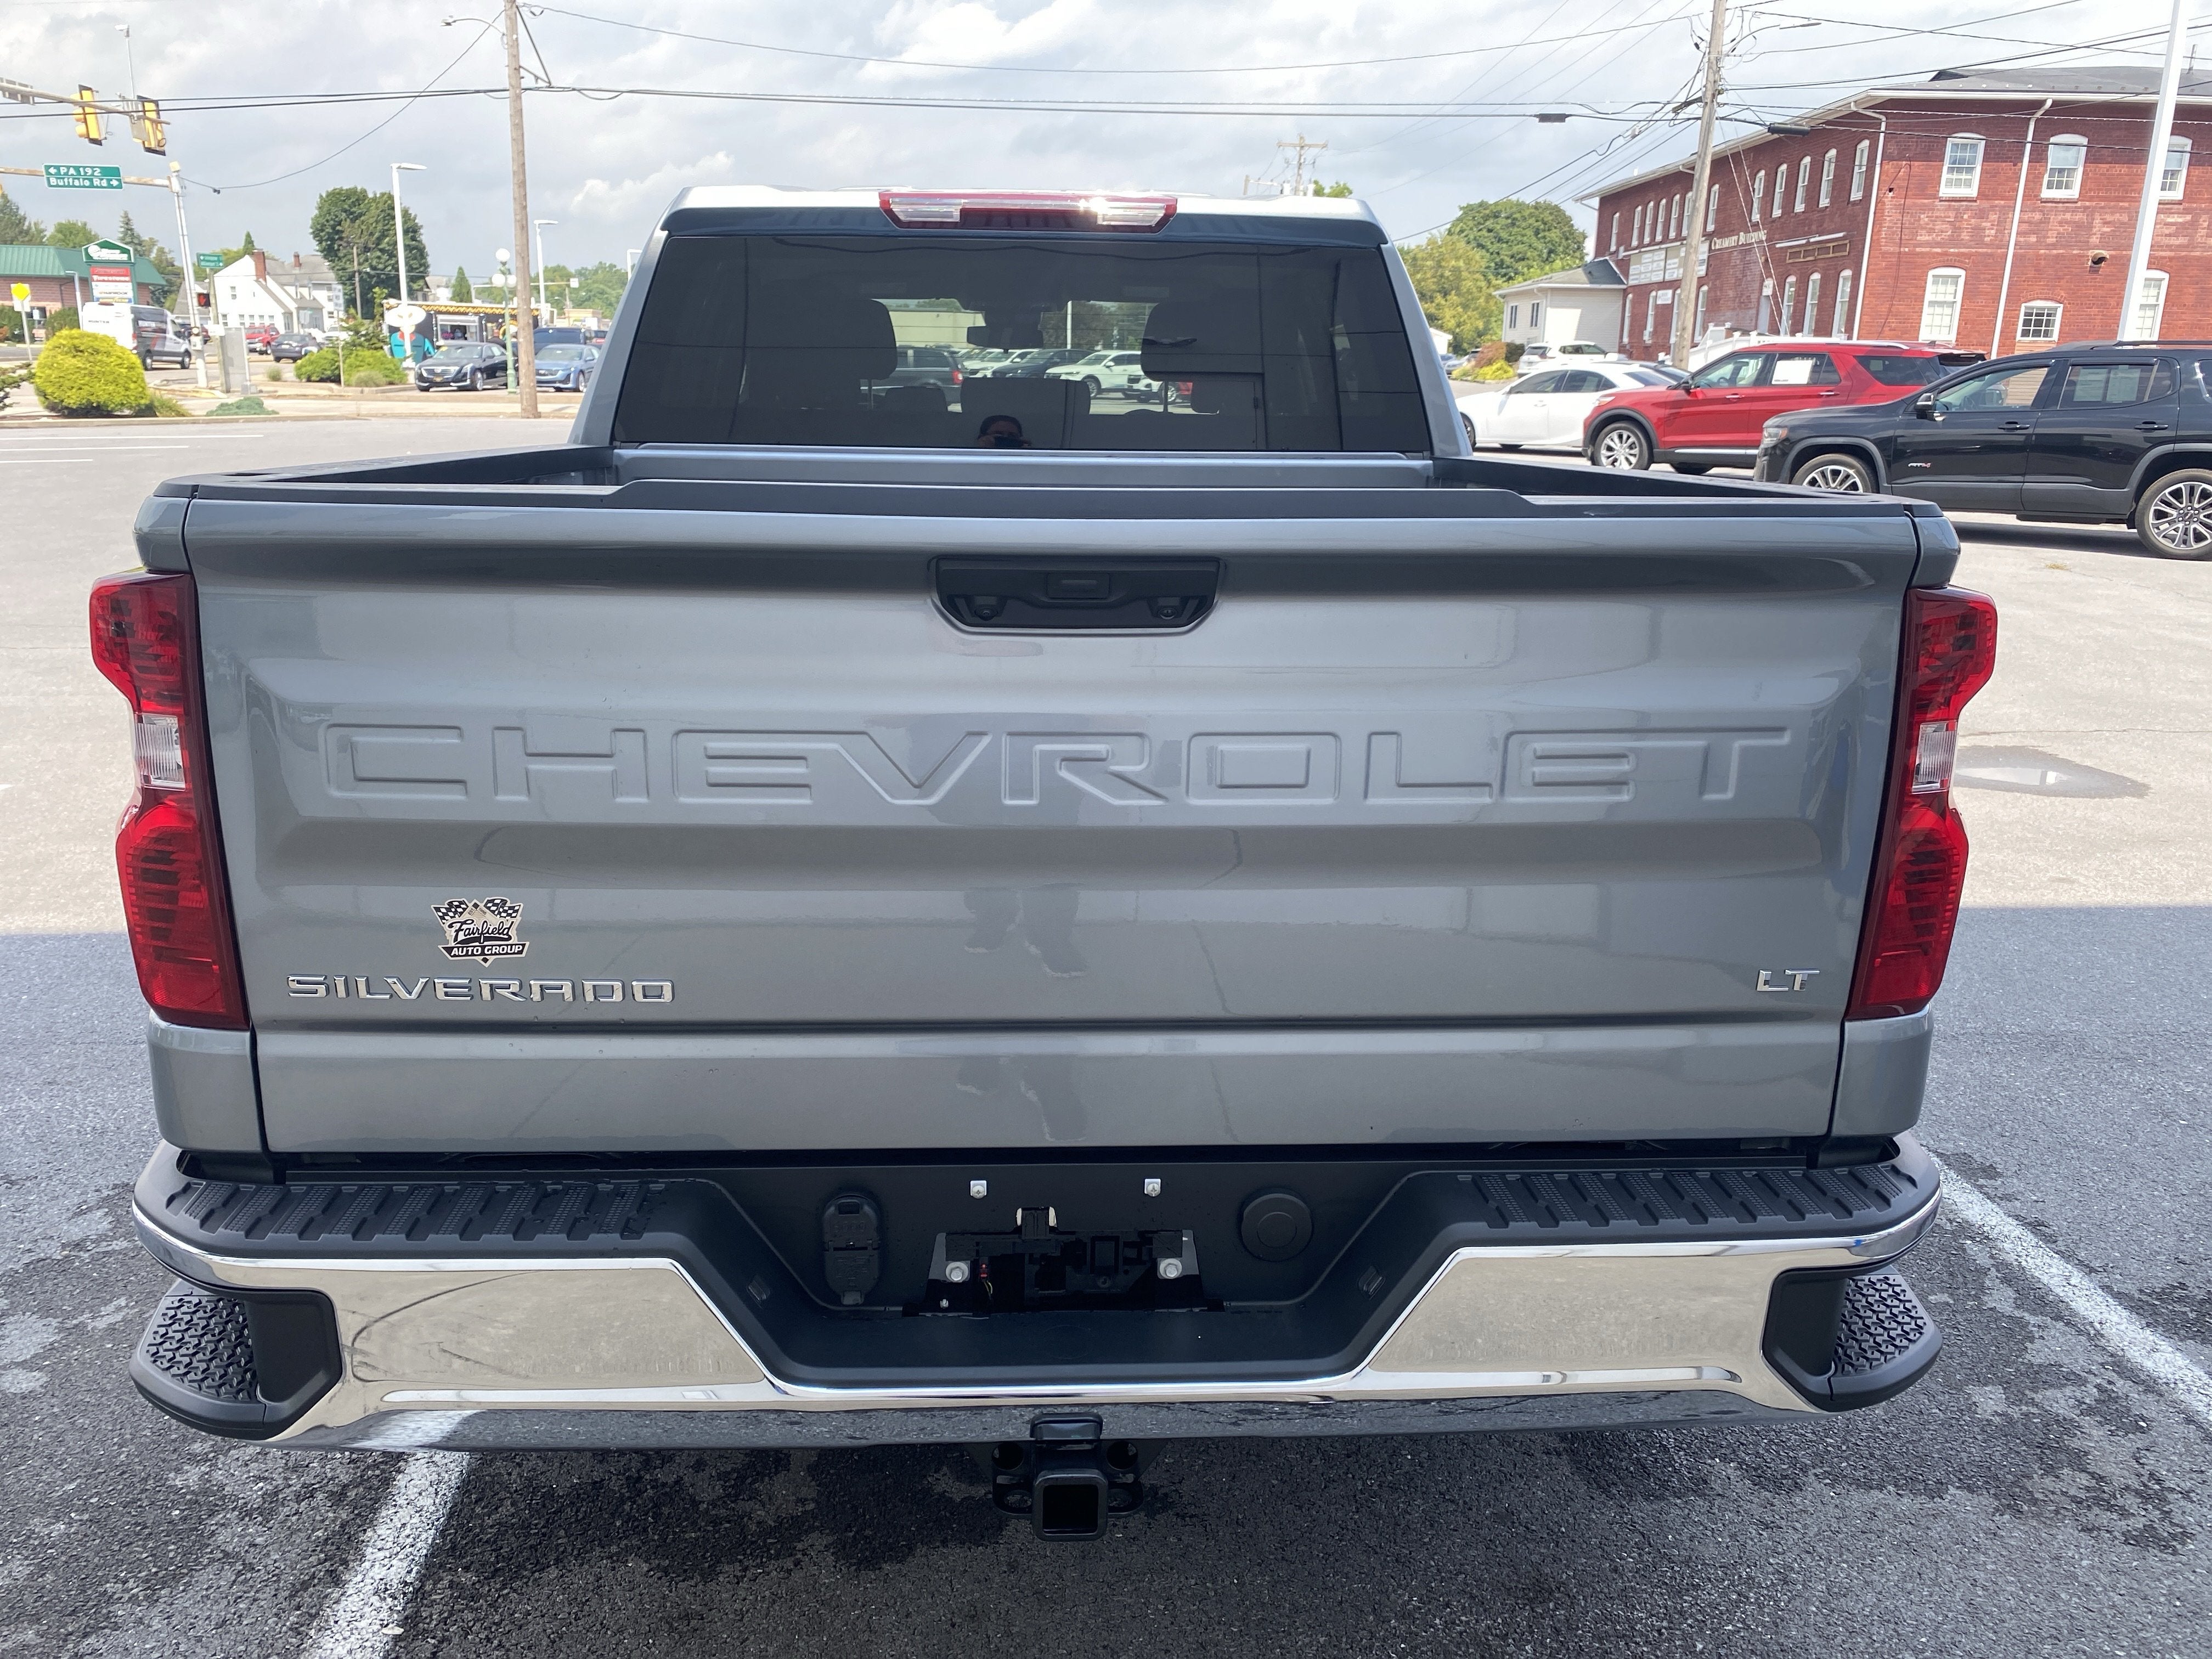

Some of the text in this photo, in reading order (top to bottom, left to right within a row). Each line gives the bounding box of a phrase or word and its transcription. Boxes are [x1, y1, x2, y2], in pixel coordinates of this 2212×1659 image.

[49, 177, 108, 187] Buffalo Rd
[59, 166, 101, 176] PA 192
[324, 723, 1792, 806] CHEVROLET
[448, 919, 514, 944] Fairfield
[451, 945, 522, 956] AUTO GROUP
[286, 974, 675, 1003] SILVERADO
[1756, 968, 1820, 991] LT
